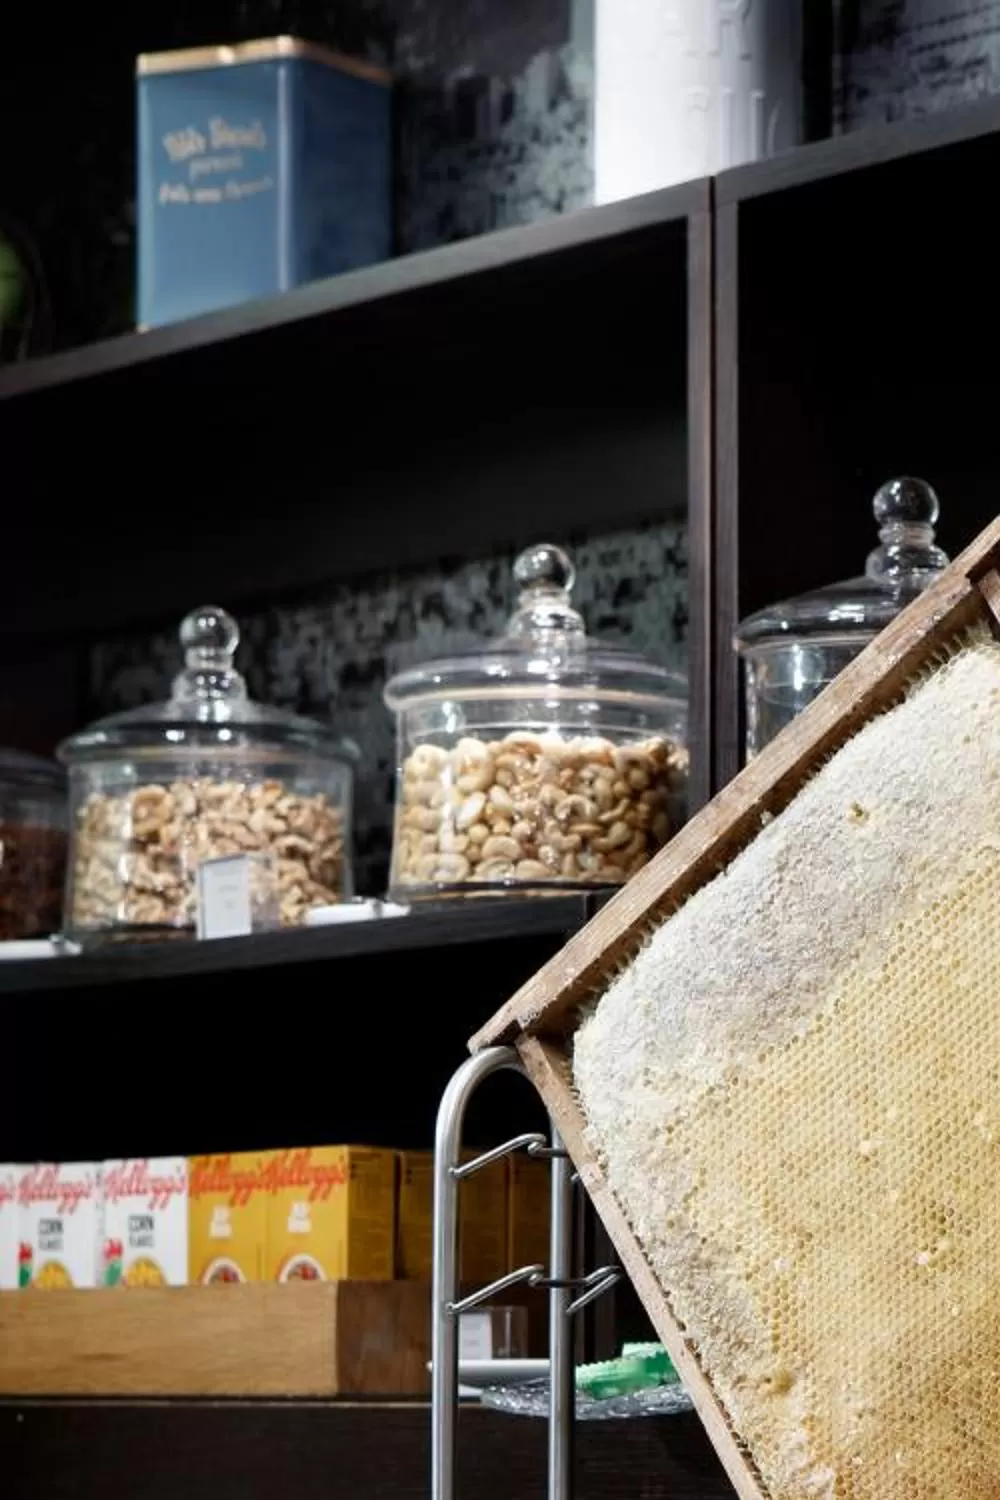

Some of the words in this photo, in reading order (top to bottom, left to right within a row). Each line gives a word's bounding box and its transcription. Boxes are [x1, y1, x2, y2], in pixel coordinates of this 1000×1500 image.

[18, 1163, 91, 1214] Kellogg's
[103, 1158, 185, 1211] Kellogg's
[188, 1152, 263, 1207] Kellogg's
[261, 1147, 346, 1202] Kellogg's
[128, 1213, 154, 1232] CORN
